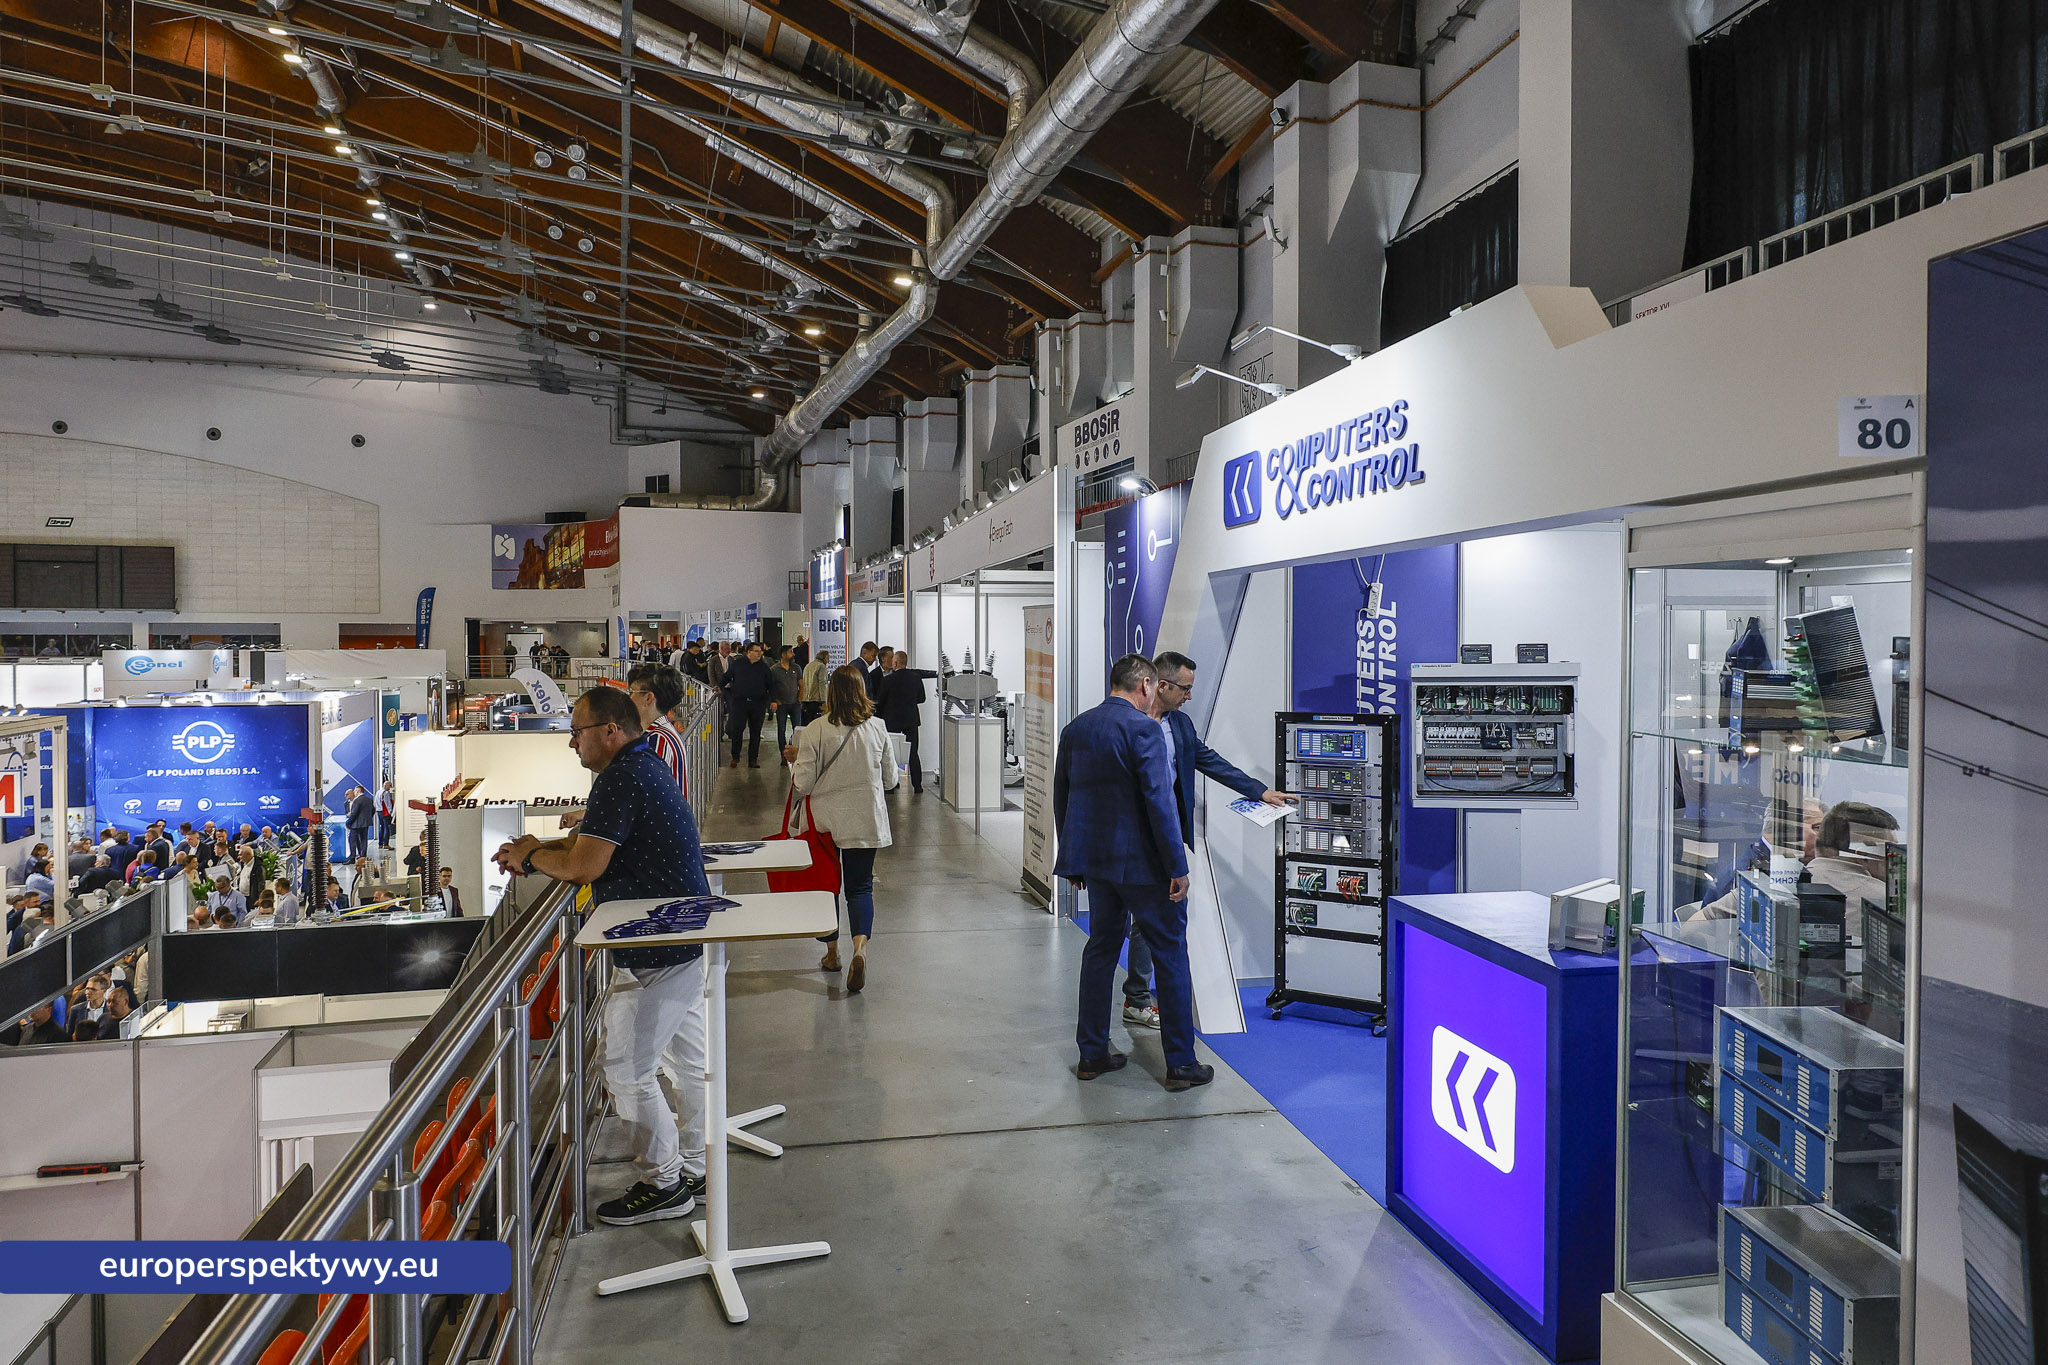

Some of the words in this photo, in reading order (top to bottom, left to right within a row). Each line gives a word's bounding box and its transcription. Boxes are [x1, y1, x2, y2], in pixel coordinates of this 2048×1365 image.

[1905, 399, 1914, 409] A
[1857, 418, 1911, 449] 80
[1266, 399, 1409, 482] COMPUTERS
[1307, 443, 1426, 509] CONTROL
[963, 579, 974, 587] 79
[1378, 600, 1397, 714] NTROL
[187, 736, 222, 749] PLP
[146, 769, 165, 777] PLP
[165, 769, 204, 777] POLAND
[205, 768, 241, 776] (BELOS)
[242, 767, 260, 775] S.A.
[532, 796, 588, 807] Polska
